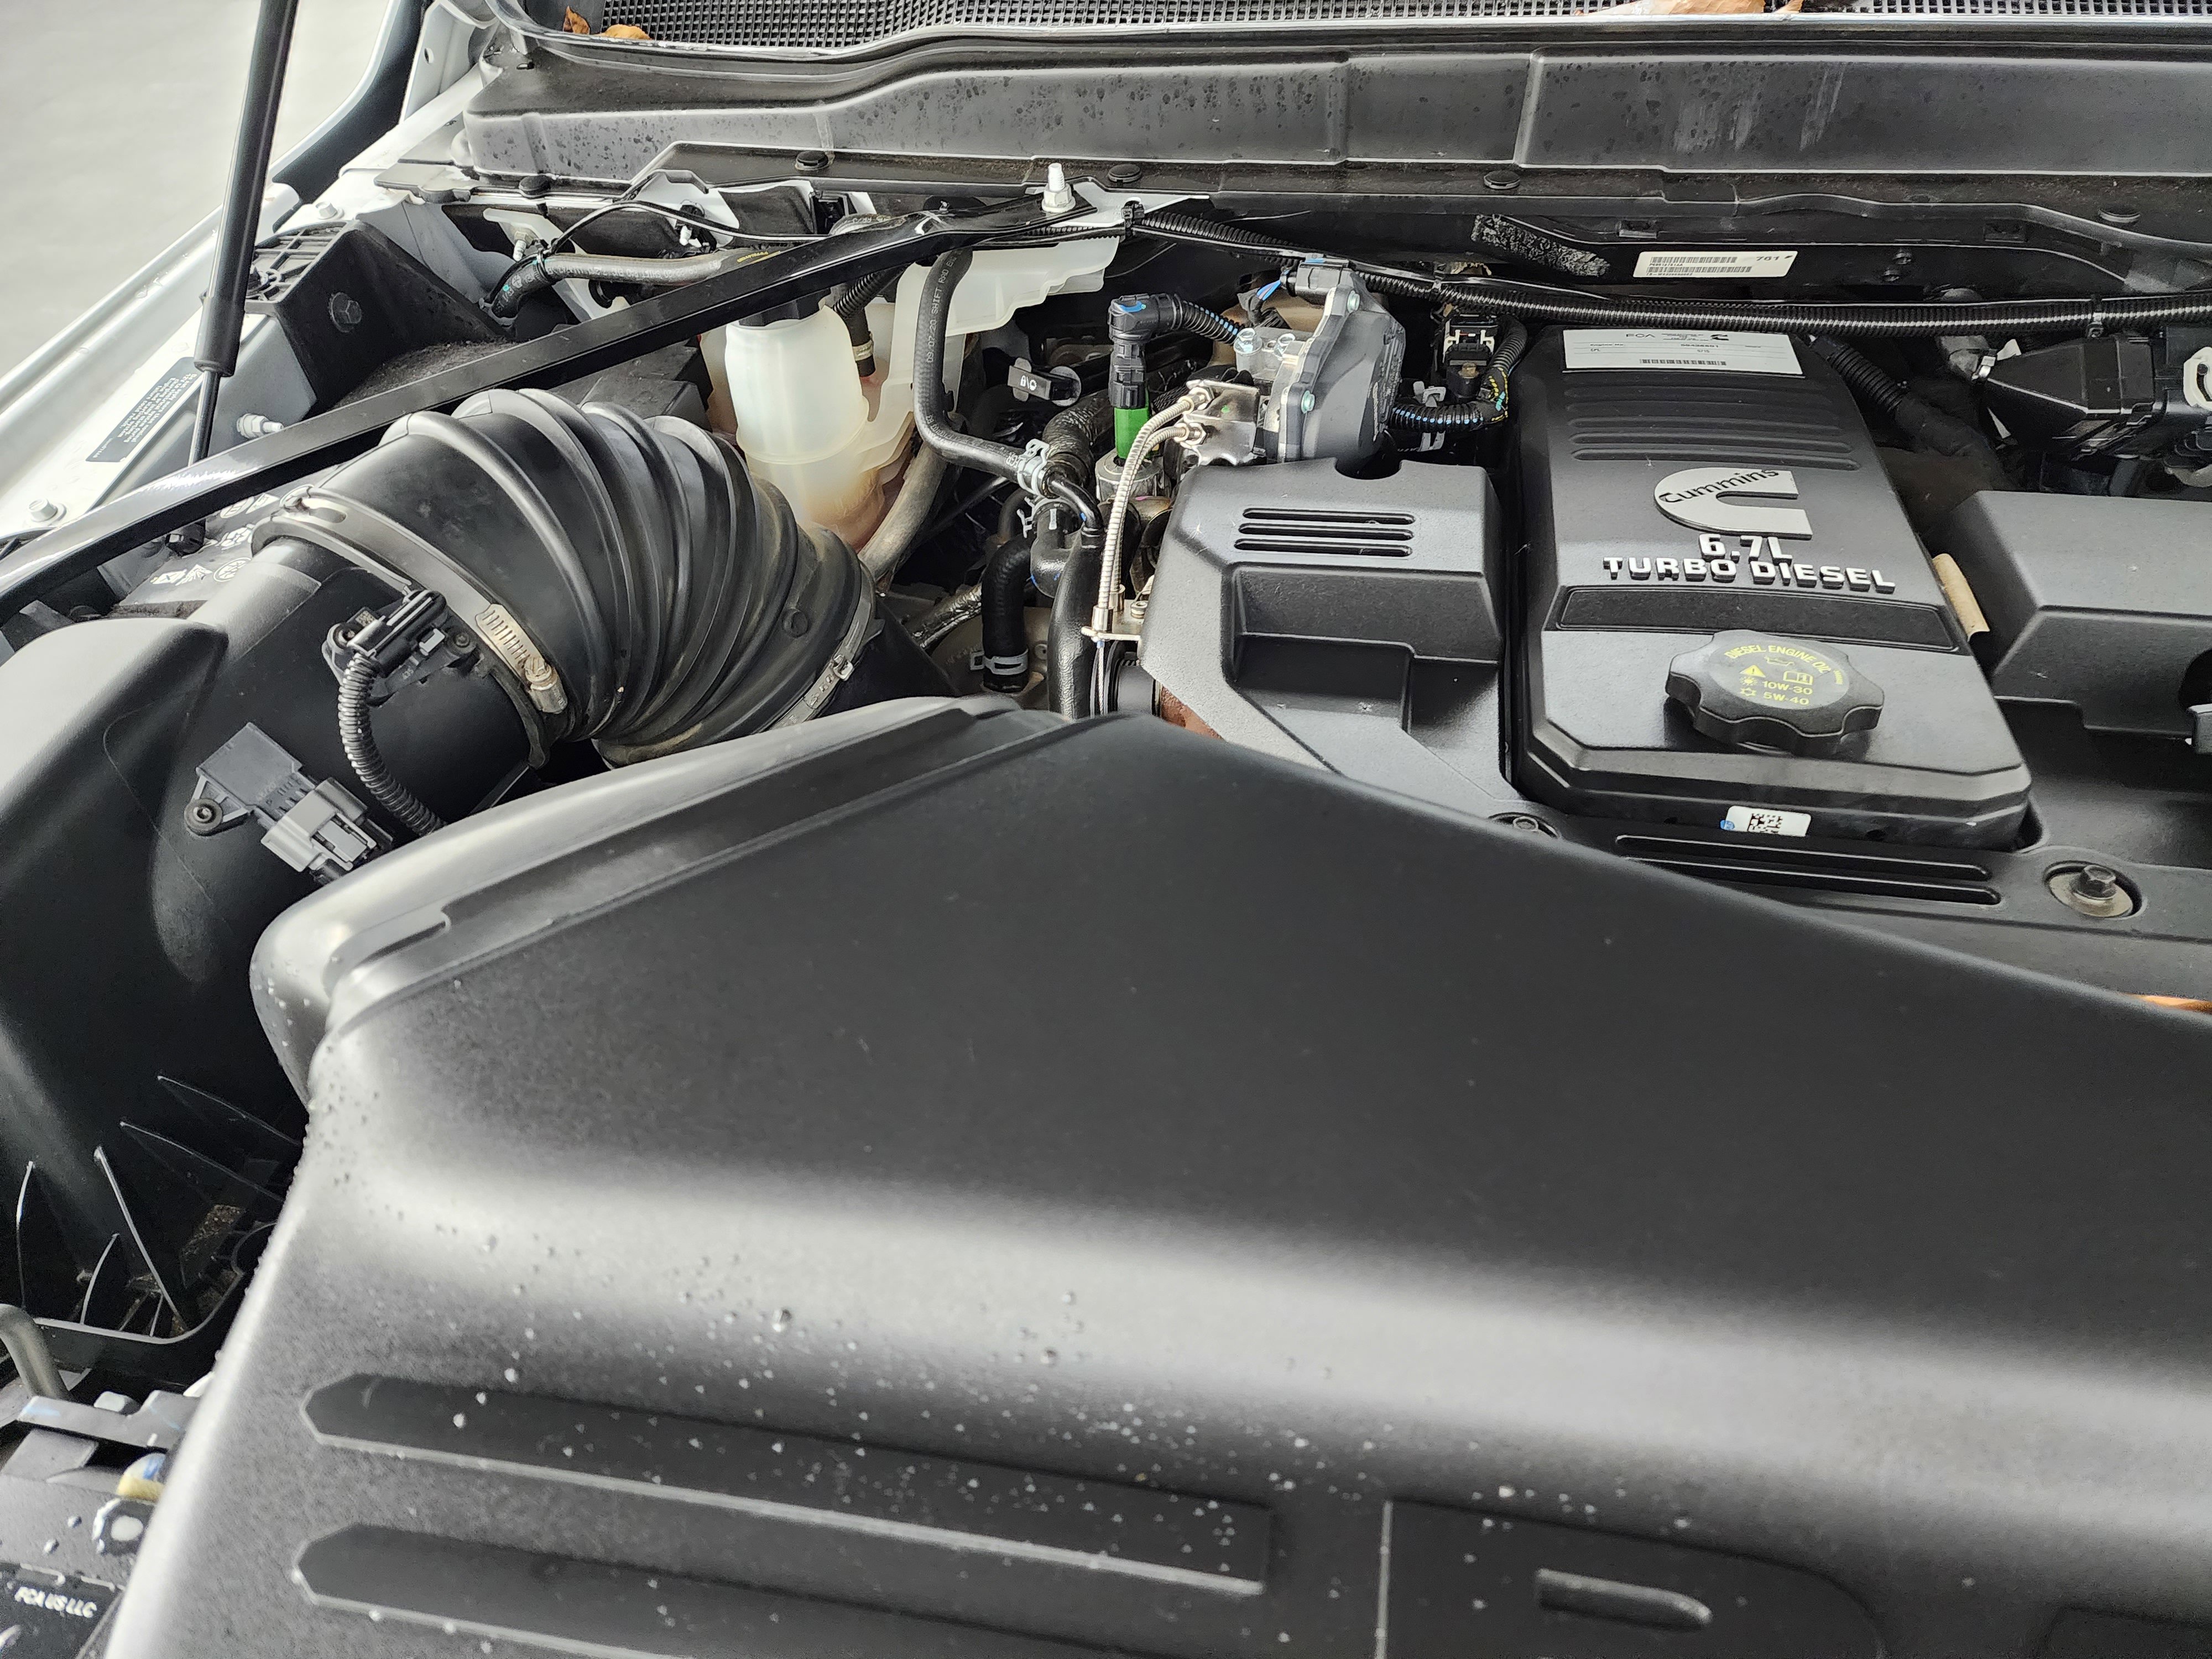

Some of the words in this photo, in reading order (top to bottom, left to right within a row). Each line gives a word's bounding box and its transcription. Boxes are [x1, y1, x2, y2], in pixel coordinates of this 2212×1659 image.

[931, 288, 943, 315] SHIFT
[1658, 469, 1780, 503] Cummins
[1699, 534, 1793, 565] 6.7L
[1603, 556, 1736, 582] TURBO
[1750, 560, 1896, 593] DIESEL
[1724, 644, 1767, 659] DIESEL
[1768, 645, 1817, 663] ENGINE
[1812, 656, 1832, 674] OIL
[1762, 681, 1813, 695] 10W-30
[1763, 691, 1810, 706] 5W-40
